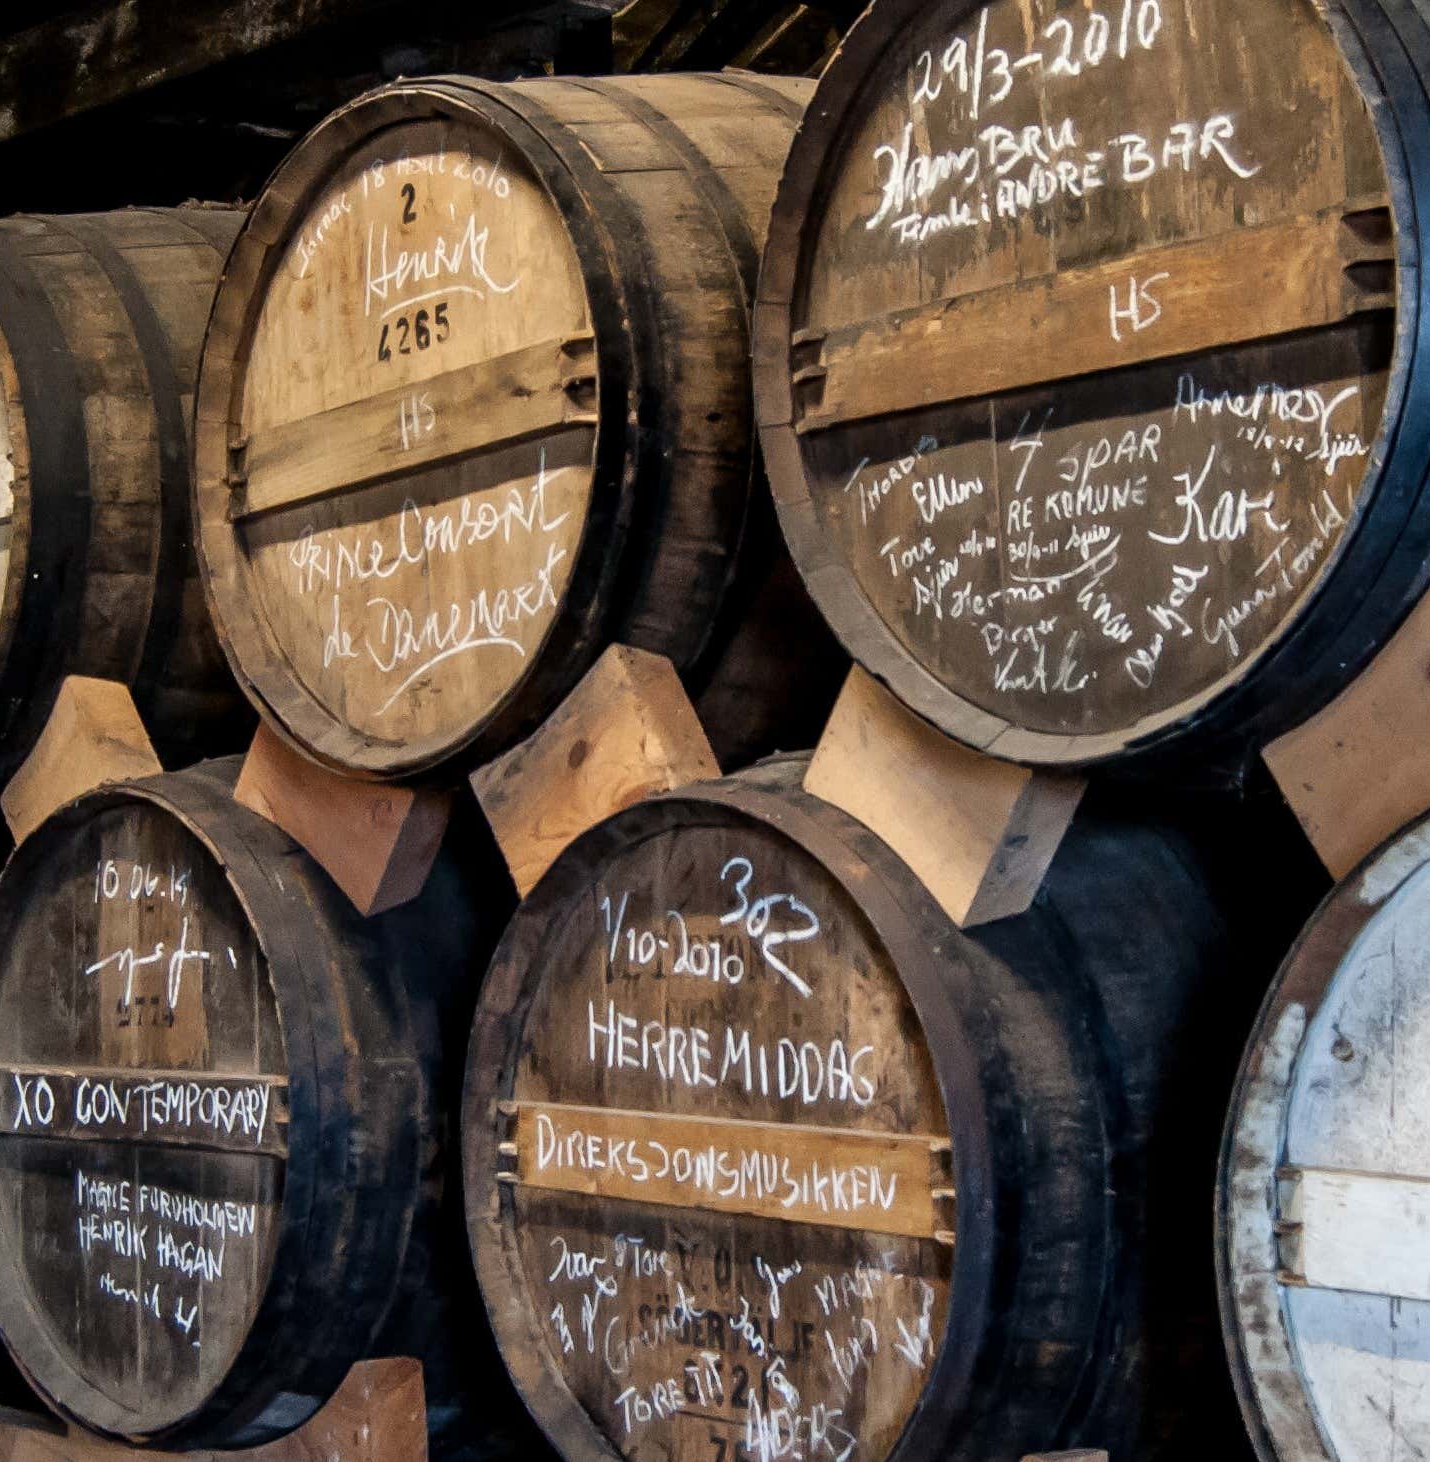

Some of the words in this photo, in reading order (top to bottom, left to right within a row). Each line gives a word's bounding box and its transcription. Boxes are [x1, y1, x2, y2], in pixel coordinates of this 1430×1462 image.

[1118, 115, 1260, 182] BAR
[401, 182, 418, 225] 2
[377, 302, 450, 363] 4265
[1108, 272, 1170, 342] HS
[75, 1078, 271, 1145] CONTEMPORARY
[78, 1213, 149, 1261] HENRIK
